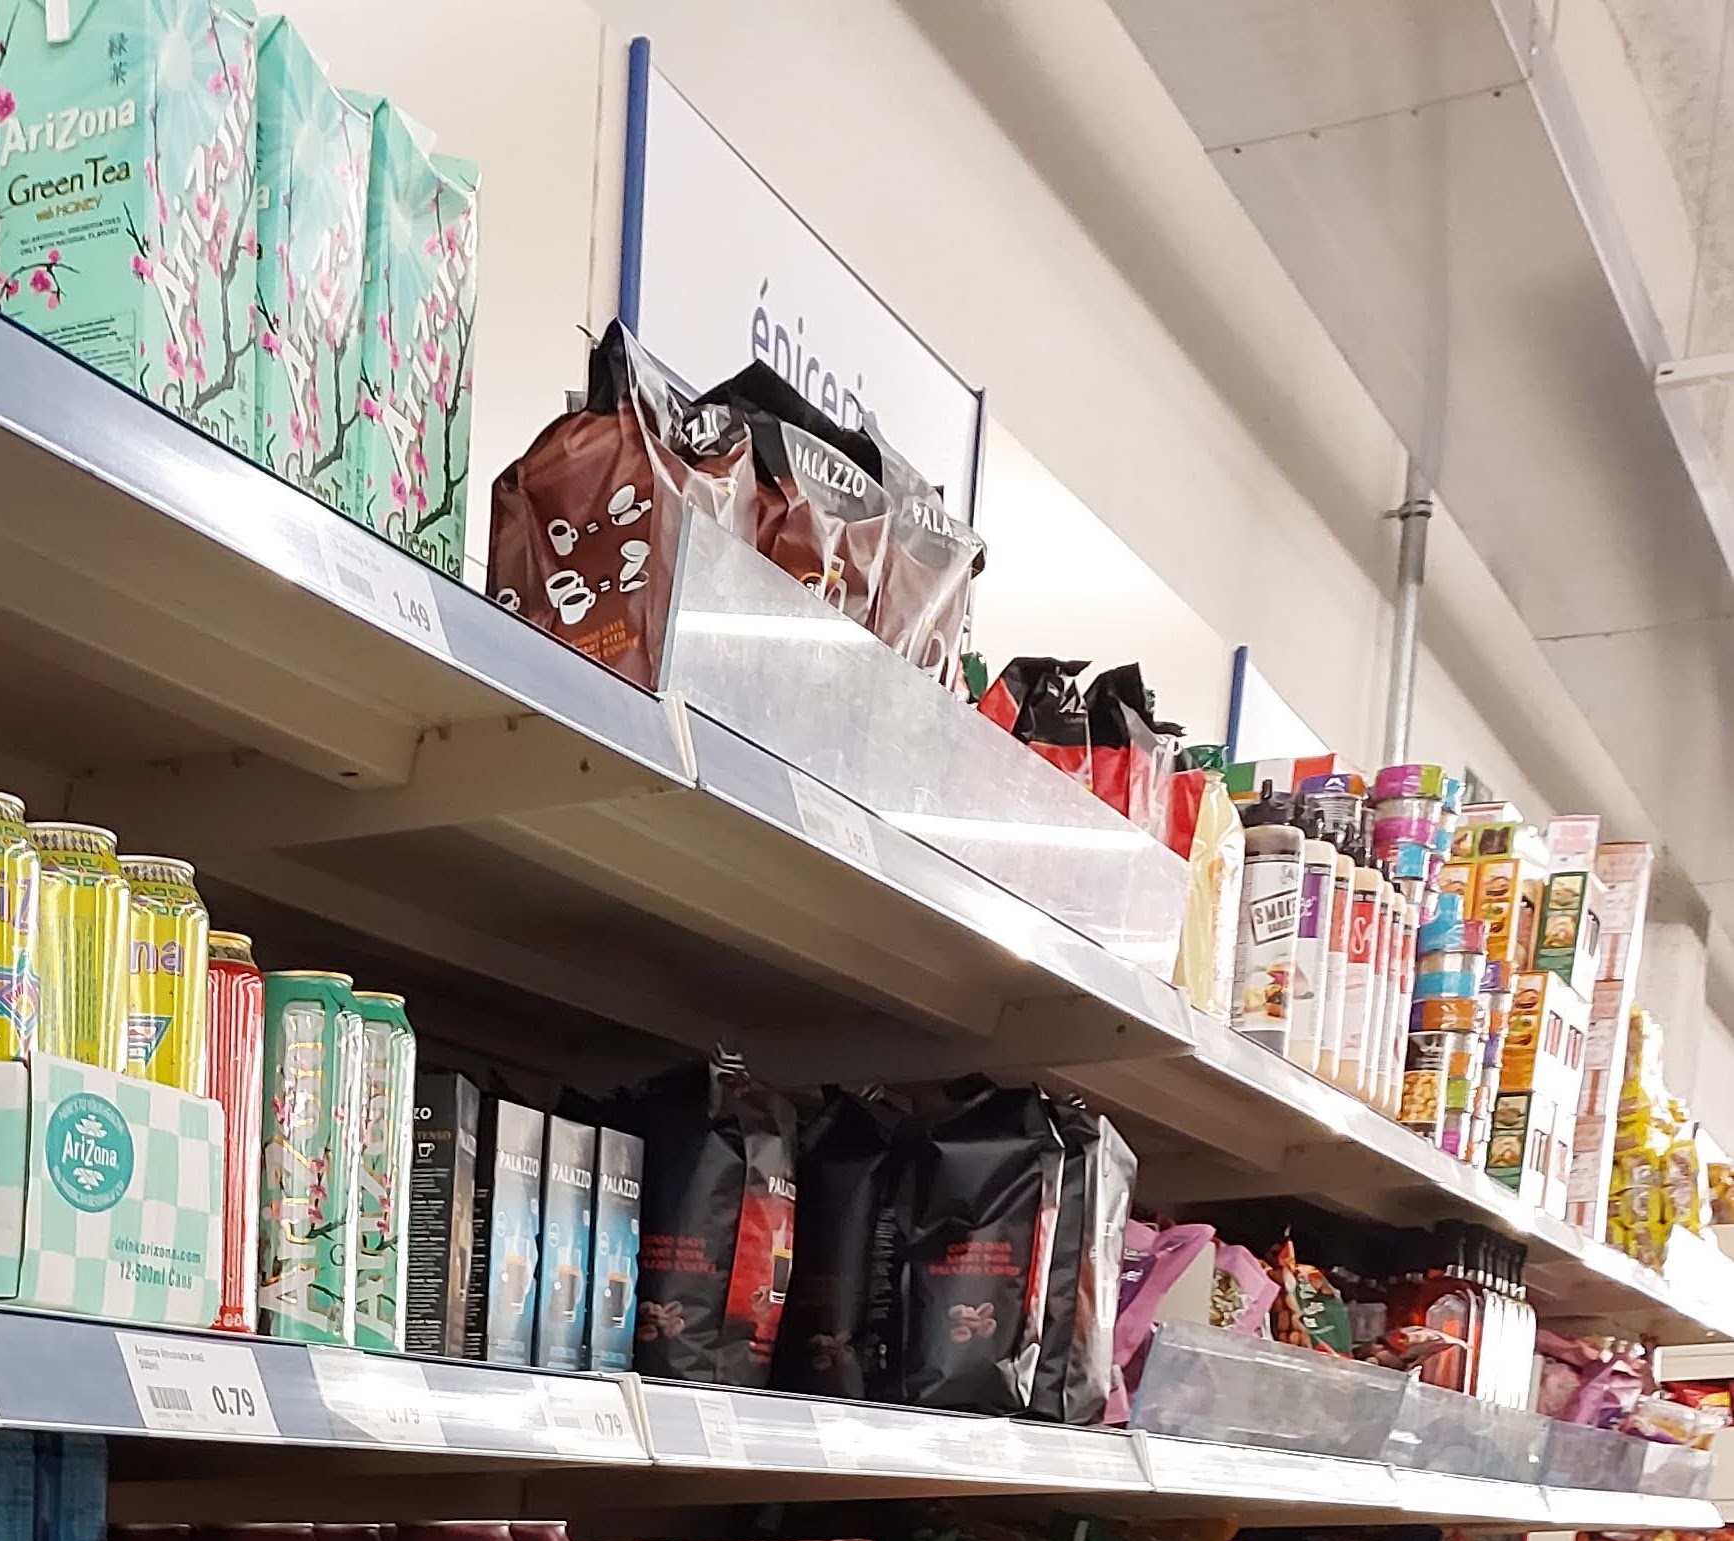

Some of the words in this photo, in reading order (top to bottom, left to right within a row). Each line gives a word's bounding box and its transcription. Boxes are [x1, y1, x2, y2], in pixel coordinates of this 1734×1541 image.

[0, 97, 135, 166] AriZona
[8, 173, 84, 206] Green
[85, 154, 131, 188] Tea
[795, 442, 867, 498] PALAZZO
[393, 590, 432, 633] 1.49
[61, 1130, 118, 1167] AriZona
[499, 1149, 539, 1178] PALAZZO
[552, 1160, 591, 1190] PALAZZO
[602, 1172, 640, 1200] PALAZZO
[114, 1235, 202, 1264] drinkarizona.com
[168, 1265, 193, 1290] Cans
[212, 1385, 256, 1417] 0.79
